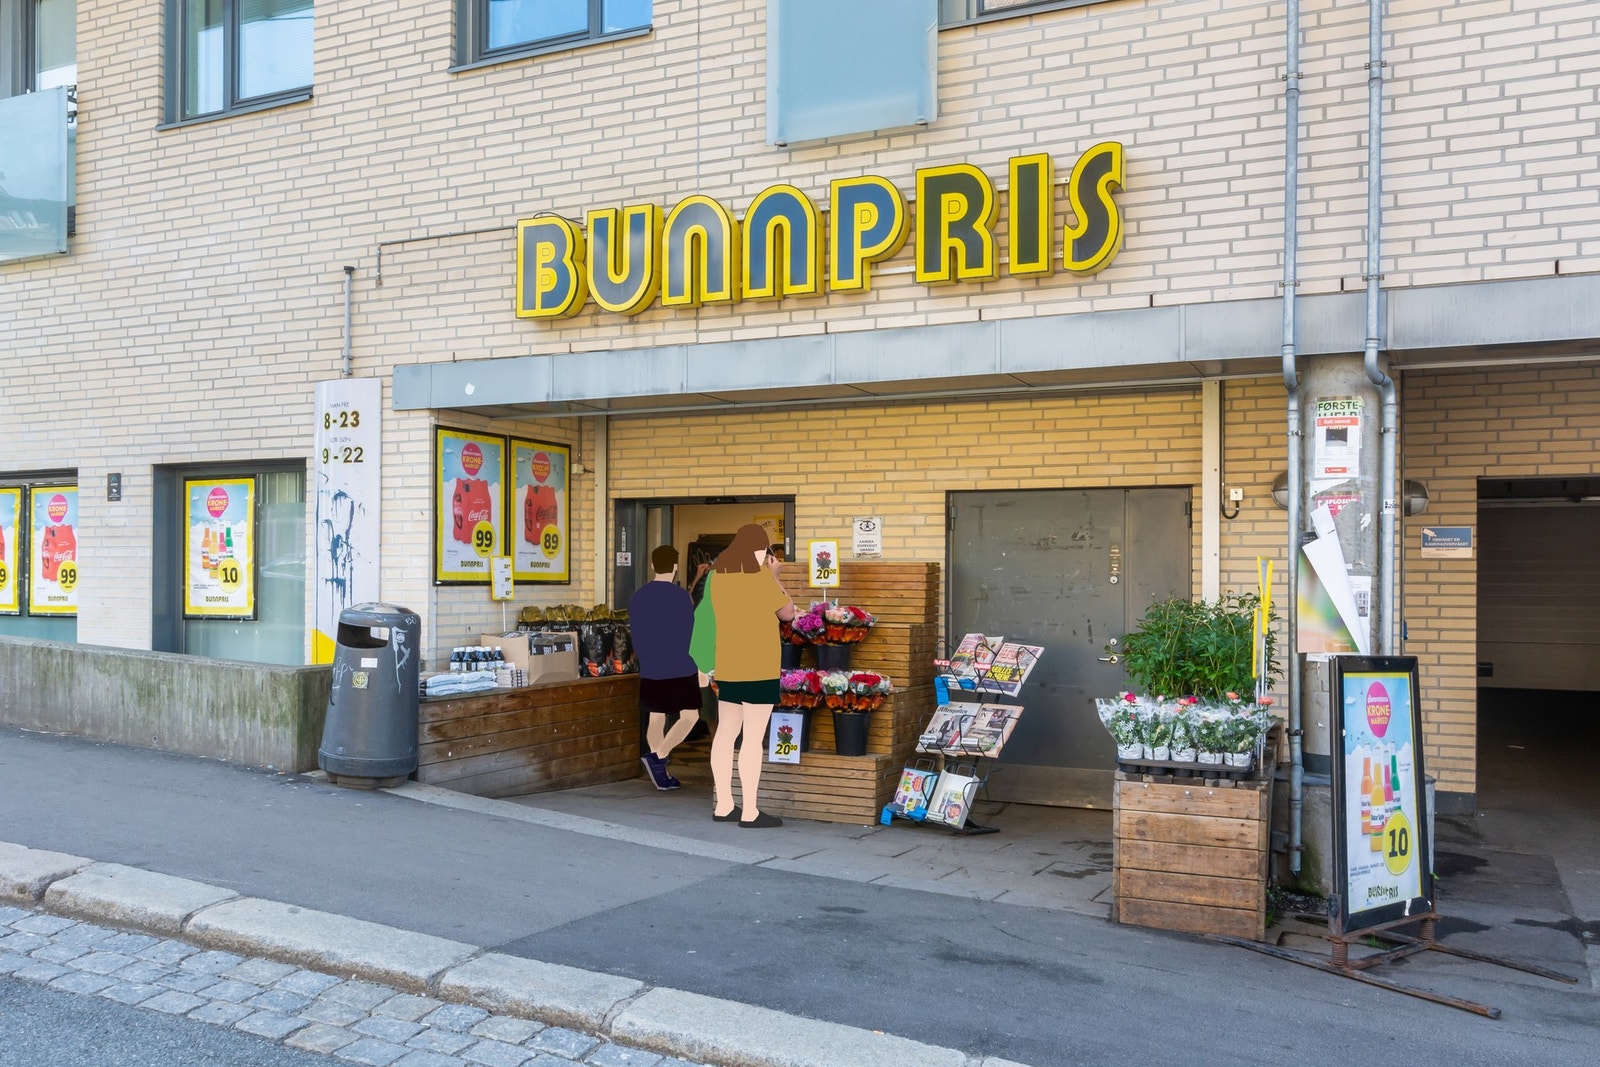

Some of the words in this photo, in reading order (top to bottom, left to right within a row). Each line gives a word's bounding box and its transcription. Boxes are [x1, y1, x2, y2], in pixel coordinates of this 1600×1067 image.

[516, 141, 1126, 320] BUNNPRIS
[476, 530, 492, 548] 99
[544, 533, 559, 550] 89
[60, 568, 77, 584] 99
[222, 567, 239, 583] 10
[1388, 826, 1409, 858] 10
